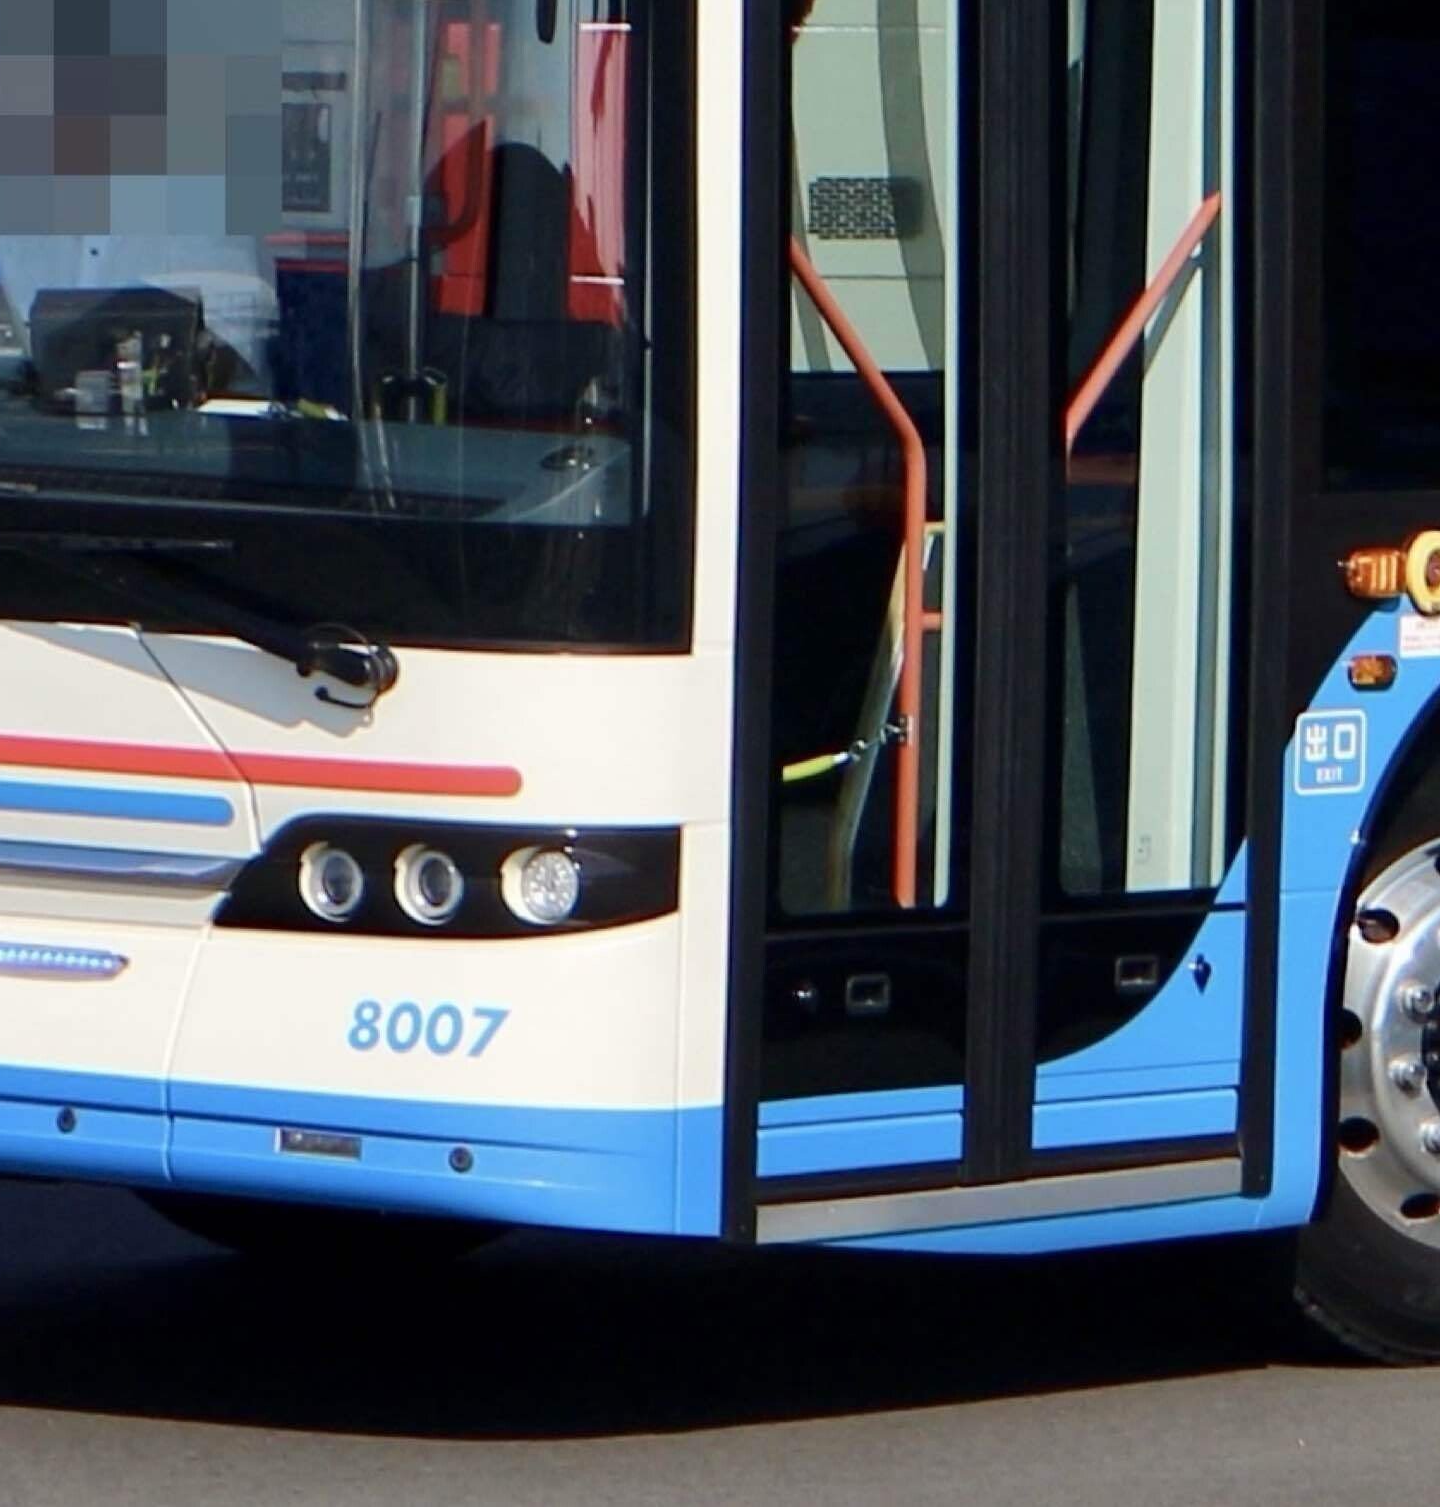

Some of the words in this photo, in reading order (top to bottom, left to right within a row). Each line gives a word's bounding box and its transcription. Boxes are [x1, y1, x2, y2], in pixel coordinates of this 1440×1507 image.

[1304, 722, 1357, 762] 出口
[1315, 766, 1344, 784] EXIT
[347, 999, 513, 1059] 8007
